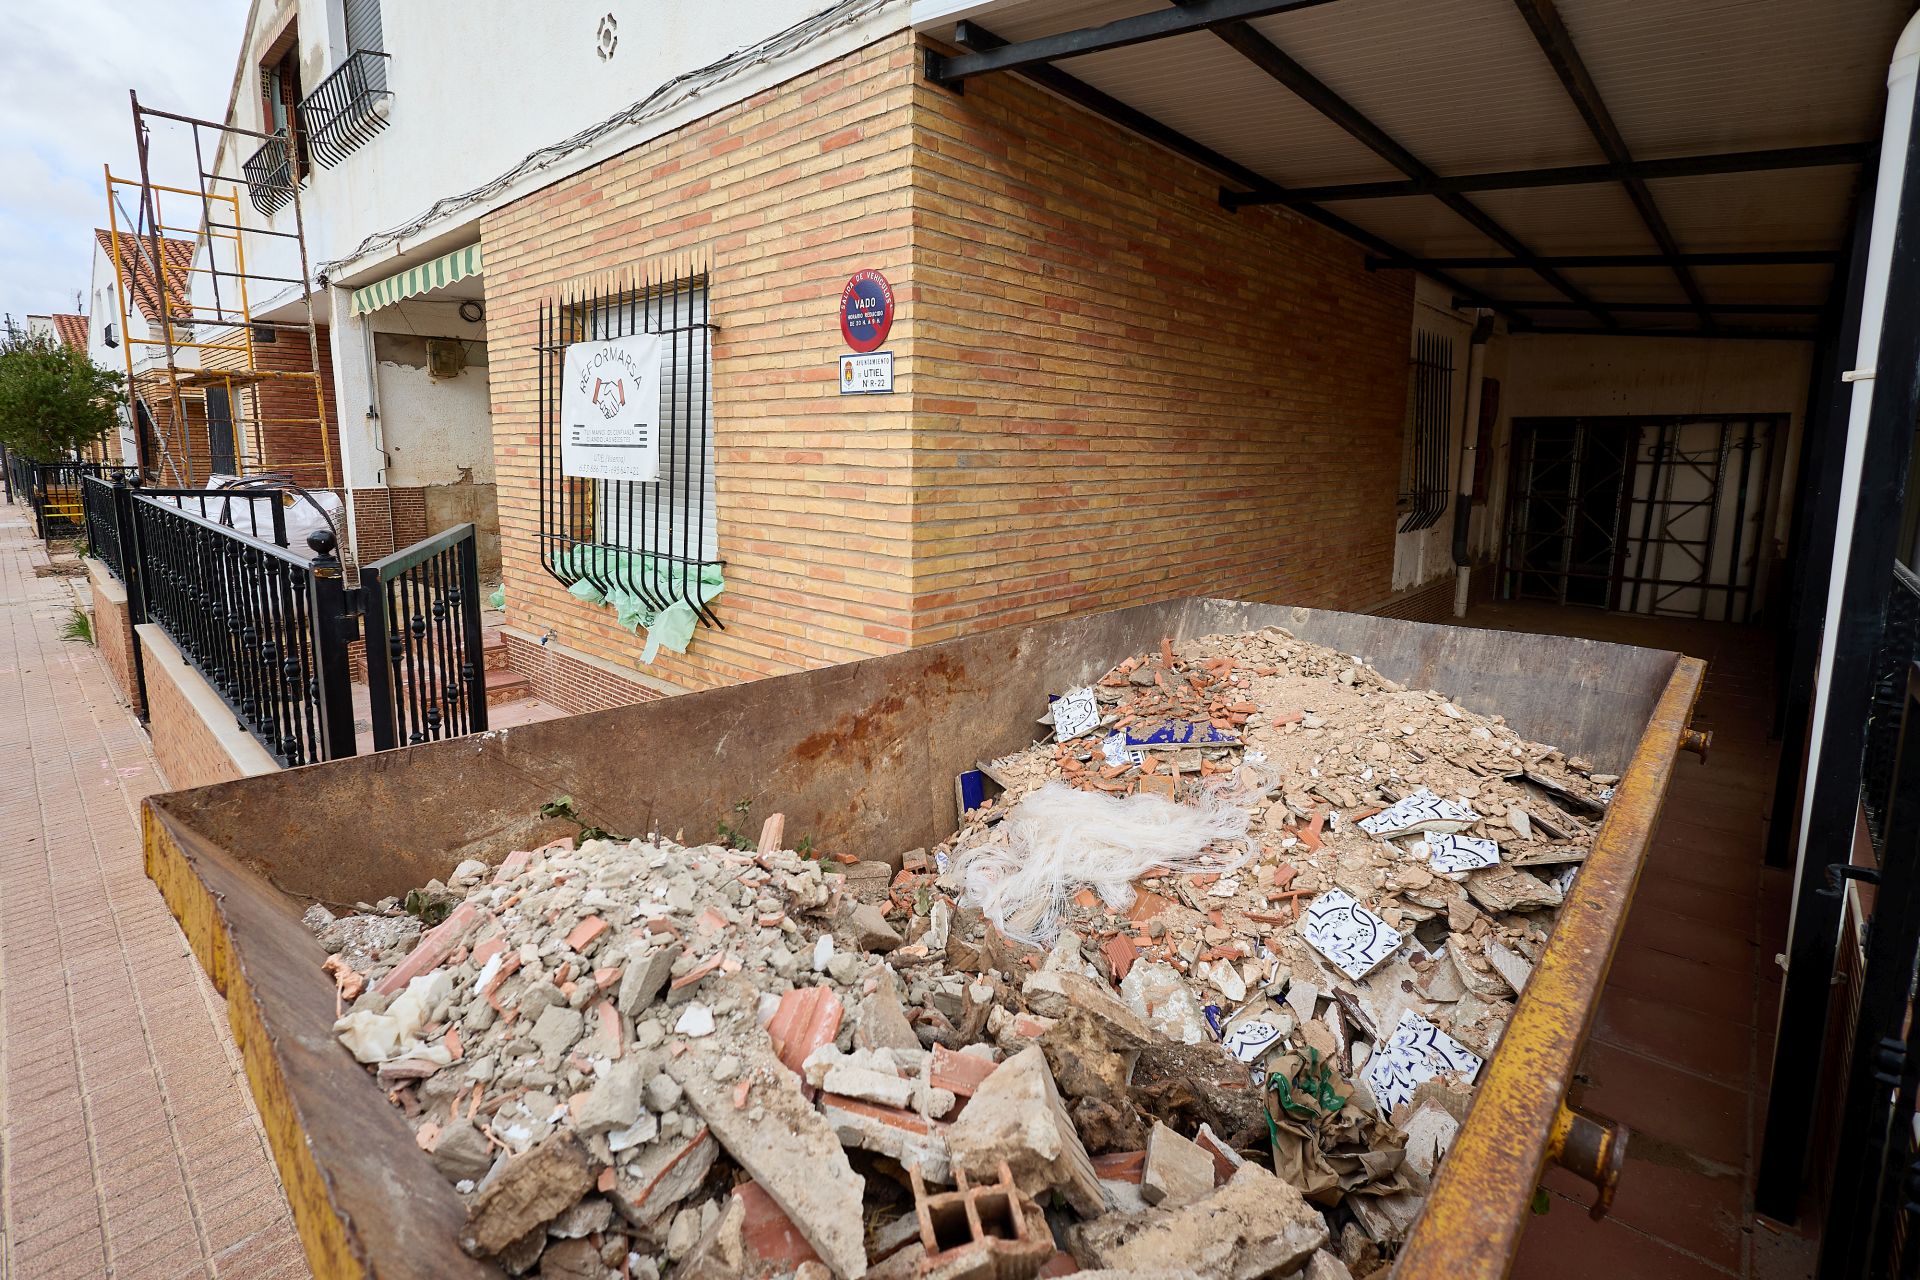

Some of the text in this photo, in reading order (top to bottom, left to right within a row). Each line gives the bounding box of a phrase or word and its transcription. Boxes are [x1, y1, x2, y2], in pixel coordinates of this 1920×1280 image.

[841, 271, 892, 310] SALIDA DE VEHICULOS
[855, 297, 876, 309] VADO
[856, 357, 889, 366] AYUNTAMIENTO
[580, 346, 642, 394] REFORMARSA
[864, 368, 884, 378] UTIEL
